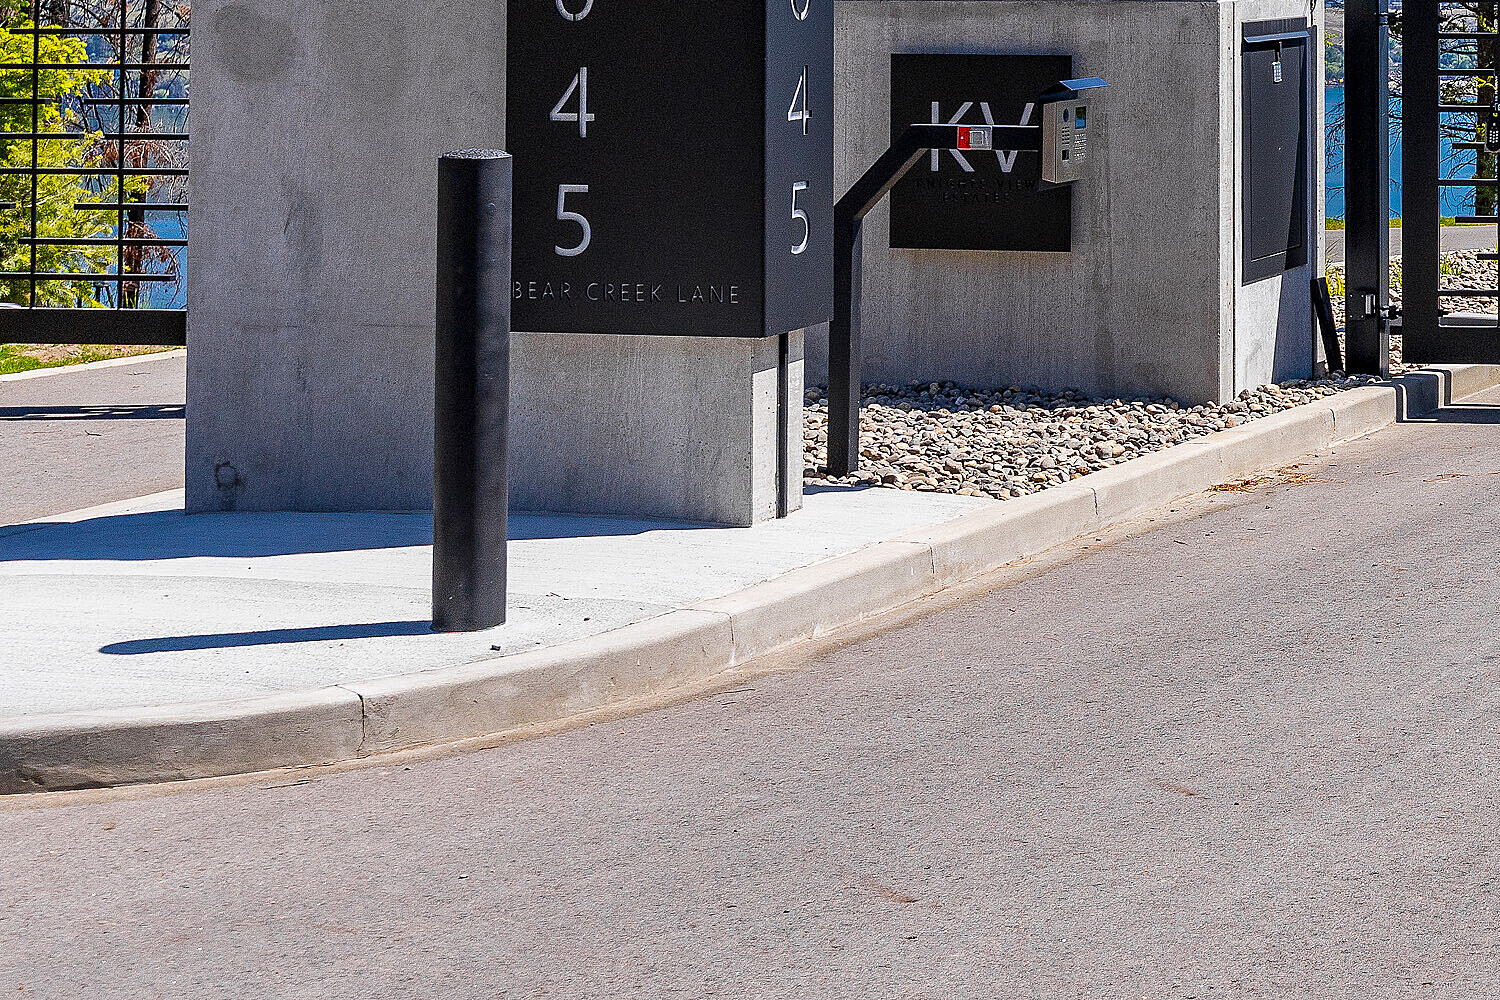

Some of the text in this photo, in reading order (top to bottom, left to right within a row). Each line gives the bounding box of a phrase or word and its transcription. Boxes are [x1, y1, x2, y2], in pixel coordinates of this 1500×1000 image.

[930, 101, 1035, 173] KV
[511, 280, 740, 304] BEAR CREEK LANE
